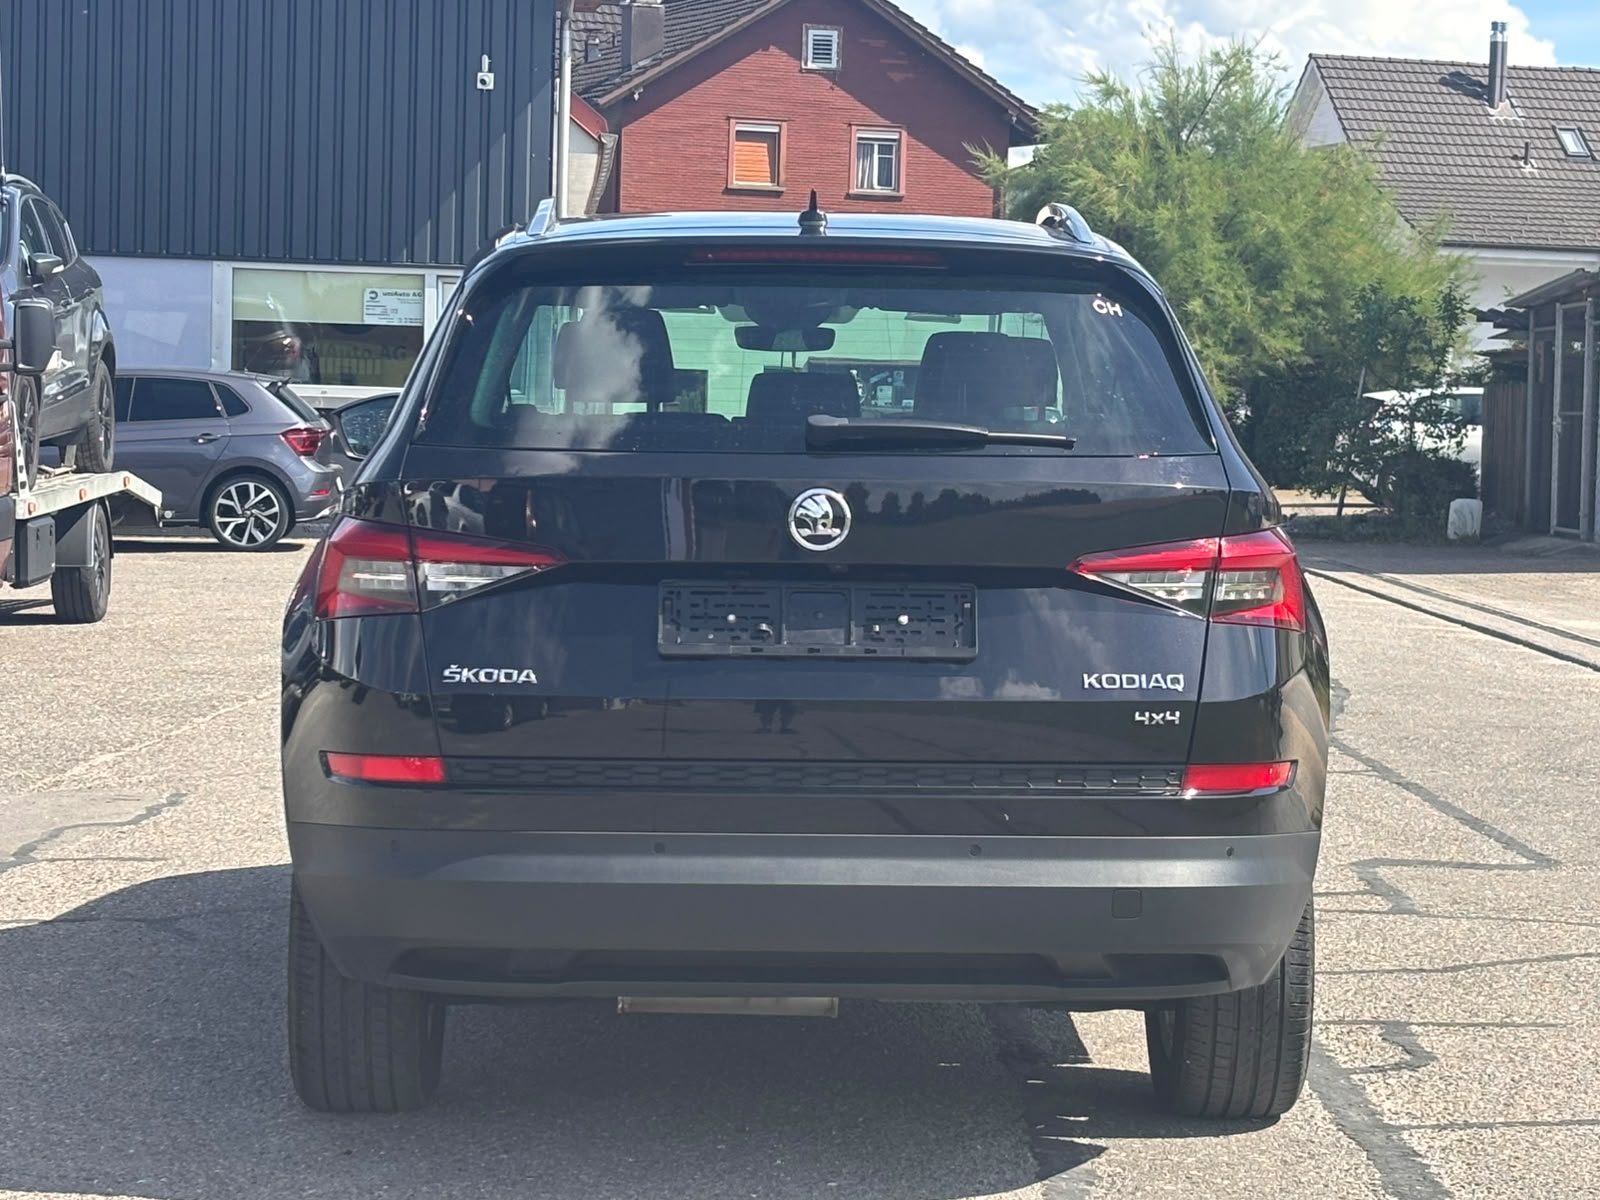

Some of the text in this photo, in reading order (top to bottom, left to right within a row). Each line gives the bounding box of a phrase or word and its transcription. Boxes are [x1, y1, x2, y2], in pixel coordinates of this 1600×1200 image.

[441, 664, 538, 684] ŠKODA
[1082, 673, 1185, 693] KODIAQ
[1134, 710, 1181, 725] 4x4
